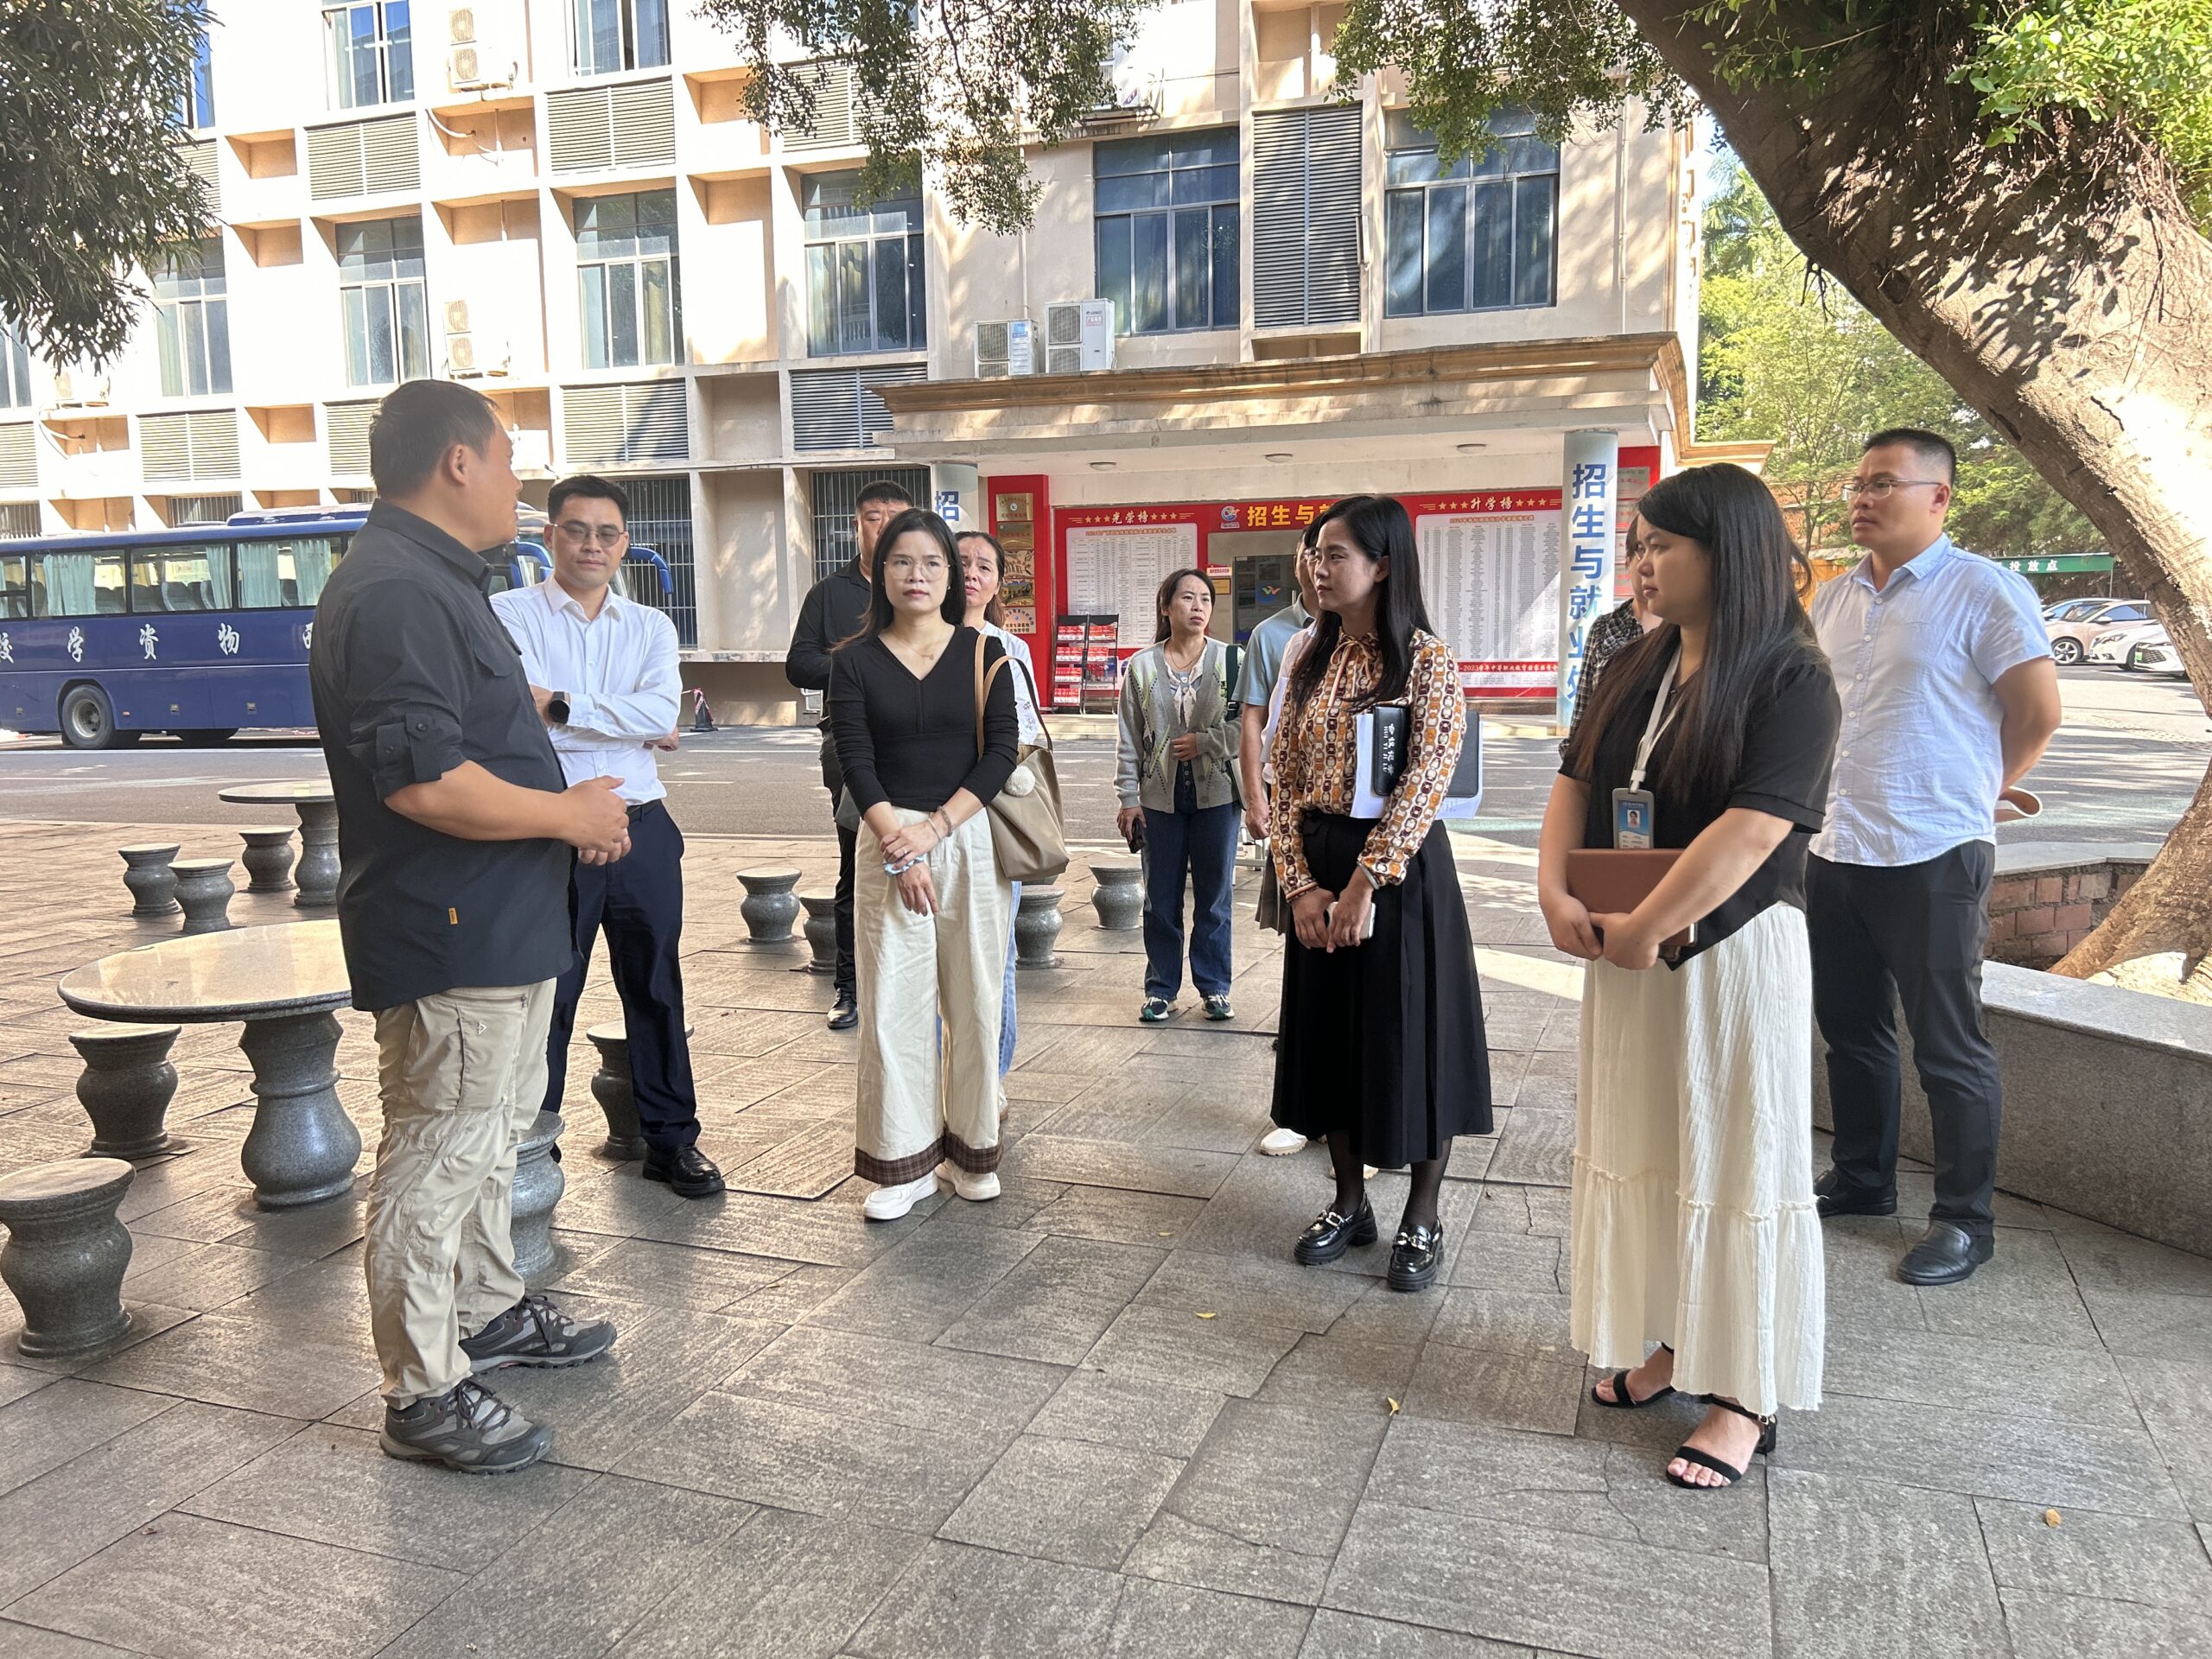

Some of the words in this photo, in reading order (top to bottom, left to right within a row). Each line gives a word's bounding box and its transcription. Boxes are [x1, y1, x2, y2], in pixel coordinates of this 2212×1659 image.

[935, 490, 959, 522] 招
[1470, 496, 1513, 512] 升学榜
[1111, 510, 1149, 524] 光荣榜
[1247, 504, 1333, 527] 招生与
[1997, 559, 2058, 573] 投放点
